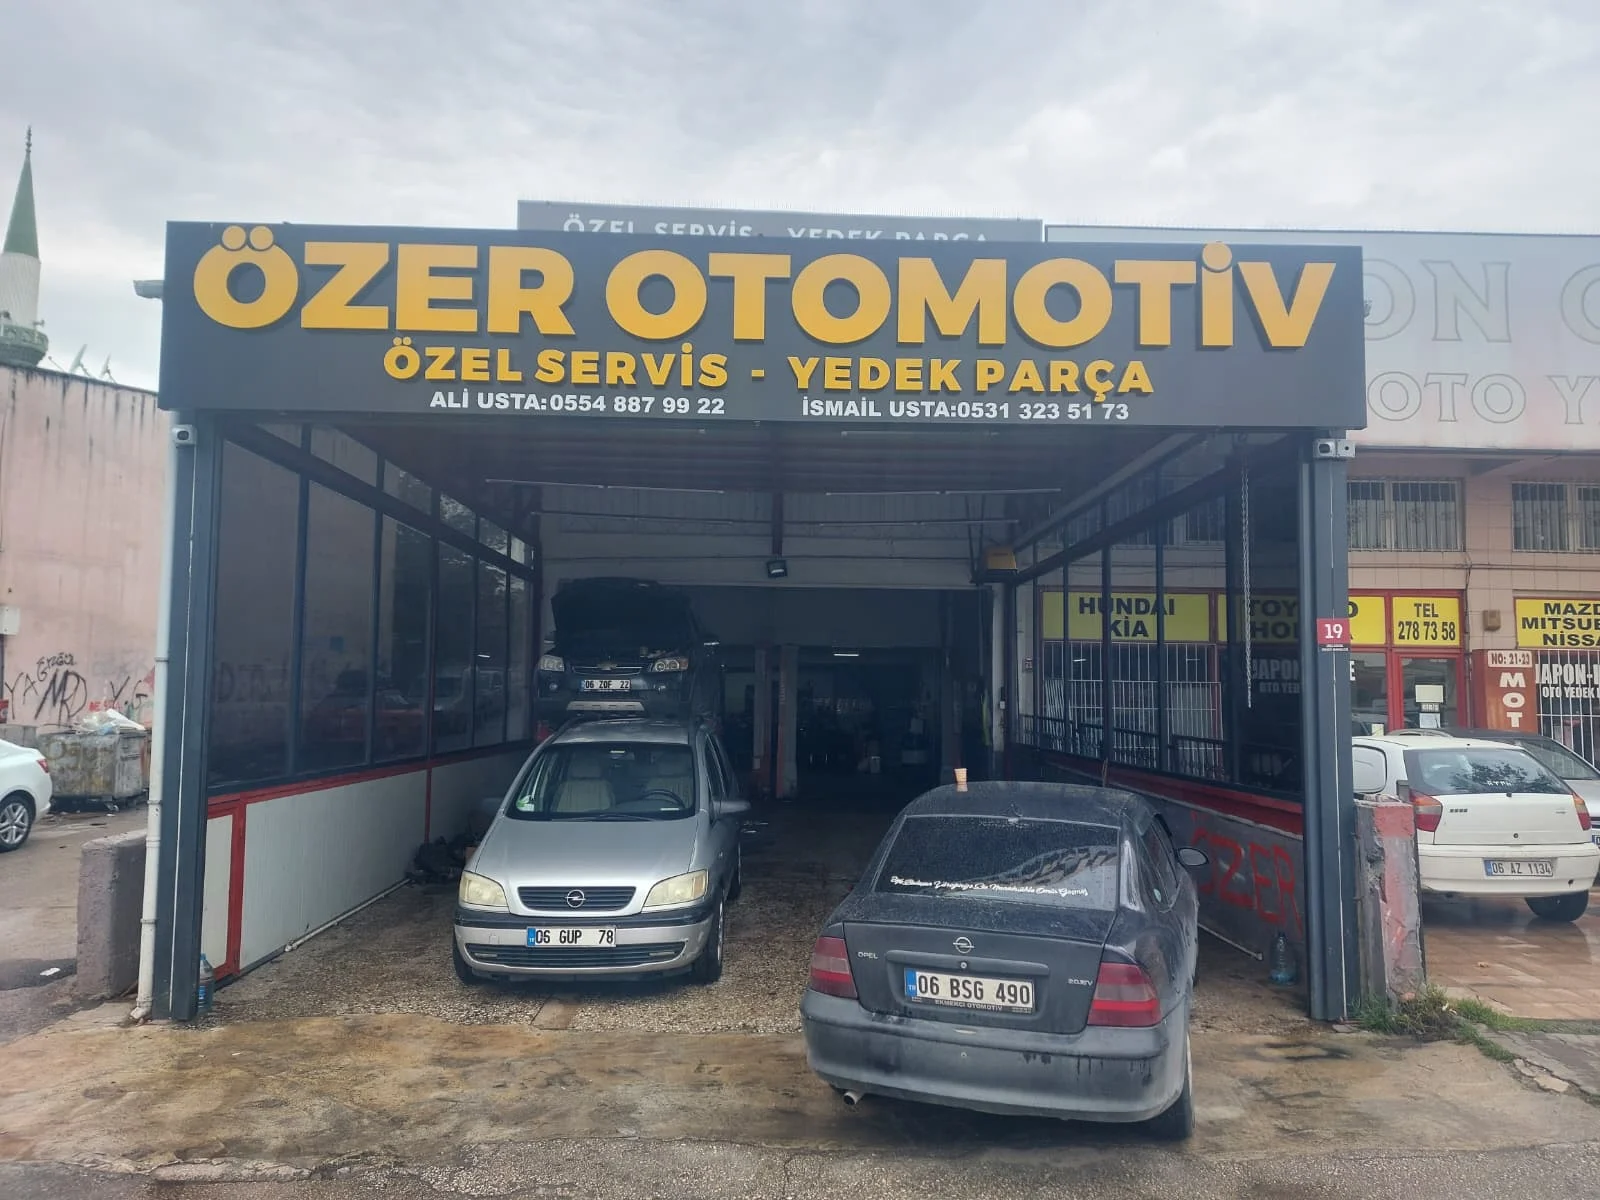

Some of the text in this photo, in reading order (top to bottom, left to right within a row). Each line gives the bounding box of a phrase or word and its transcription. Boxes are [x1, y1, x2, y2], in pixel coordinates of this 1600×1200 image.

[193, 225, 1337, 348] ÖZER OTOMOTİV
[383, 337, 522, 381] ÖZEL
[534, 342, 728, 388] SERVİS
[787, 356, 962, 391] YEDEK
[976, 359, 1155, 403] PARÇA
[429, 388, 470, 409] ALİ
[613, 396, 655, 413] 887
[662, 398, 690, 414] 99
[697, 398, 725, 415] 22
[1367, 371, 1527, 424] OTO
[802, 396, 882, 417] İSMAİL
[1019, 402, 1060, 420] 323
[1067, 403, 1093, 420] 51
[1102, 403, 1129, 420] 73
[1414, 603, 1439, 618] TEL
[1325, 623, 1343, 639] 19
[1398, 621, 1456, 640] 278 73 58
[1521, 617, 1600, 630] MITSU
[1542, 631, 1600, 646] NİSS
[620, 680, 630, 689] 22
[1492, 863, 1504, 873] 06
[559, 929, 582, 944] GUP
[598, 929, 614, 944] 78
[918, 975, 940, 996] 06
[950, 978, 984, 1000] BSG
[995, 982, 1030, 1005] 490
